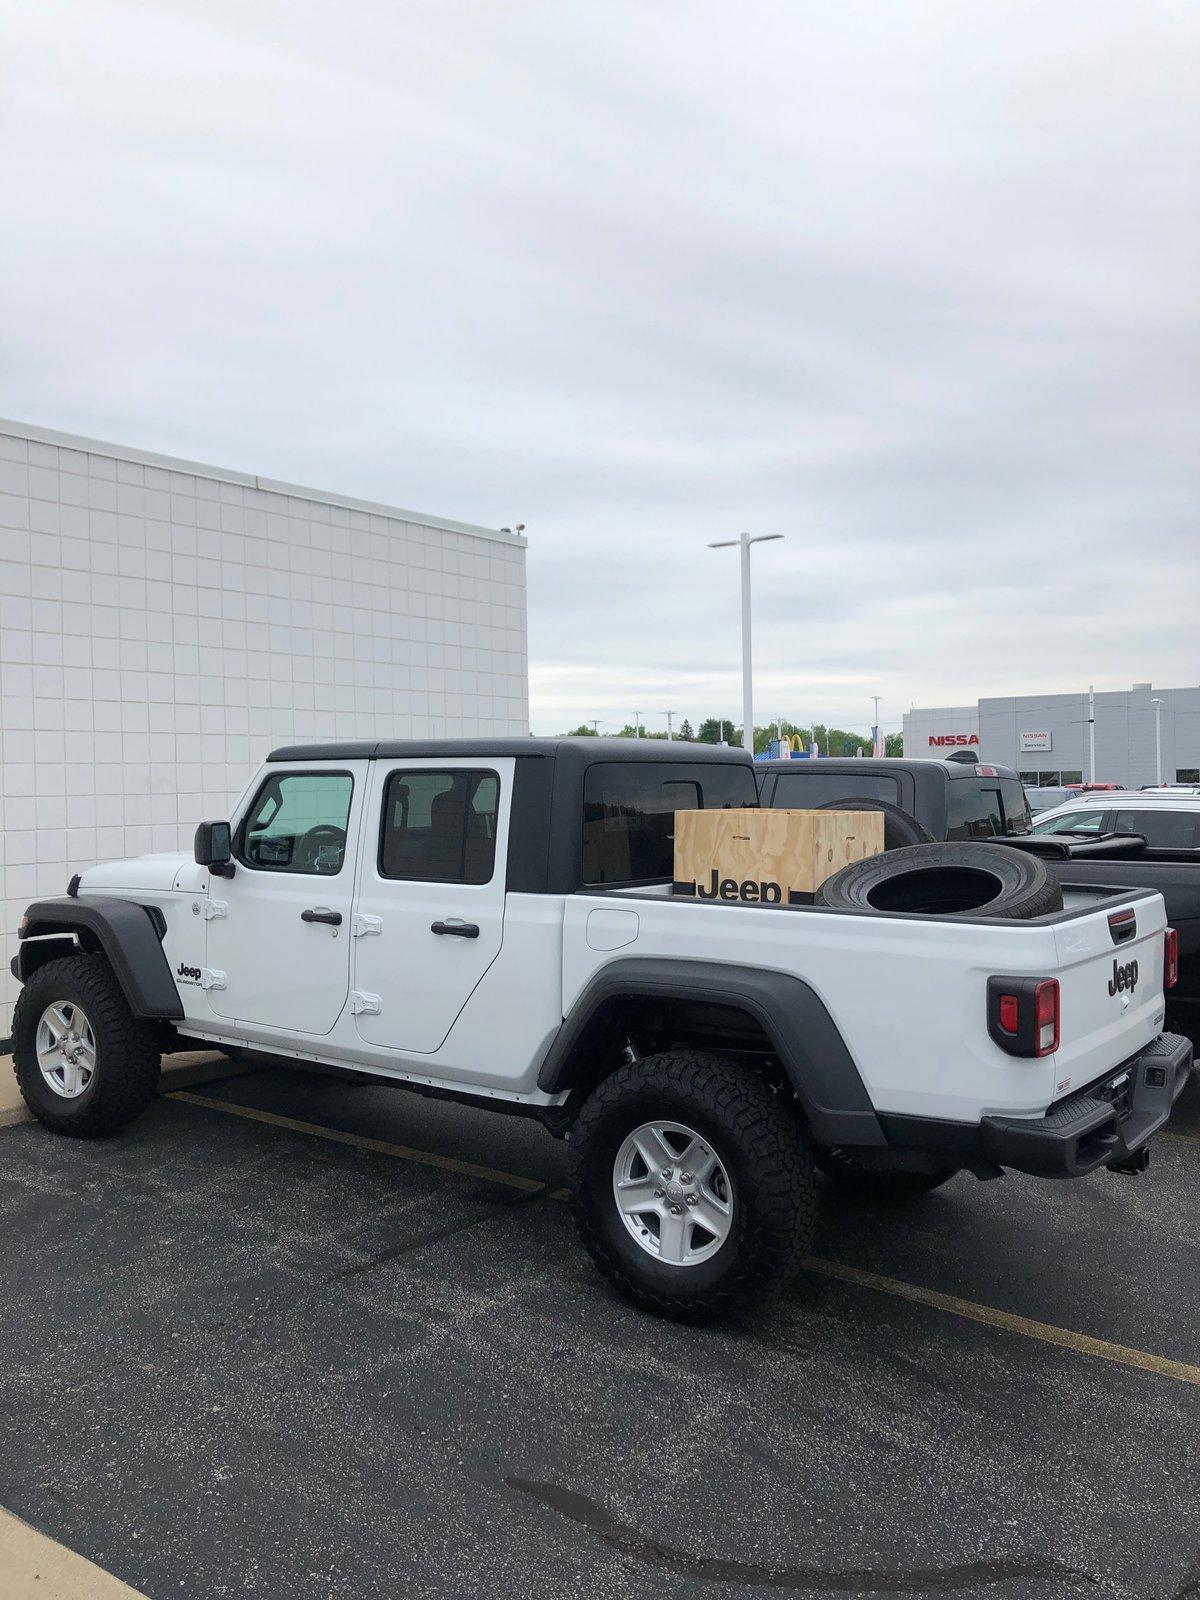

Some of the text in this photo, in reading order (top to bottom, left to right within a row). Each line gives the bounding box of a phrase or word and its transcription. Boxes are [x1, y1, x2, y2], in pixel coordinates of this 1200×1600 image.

[697, 869, 782, 903] Jeep
[177, 962, 201, 981] Jeep
[1108, 958, 1138, 997] Jeep
